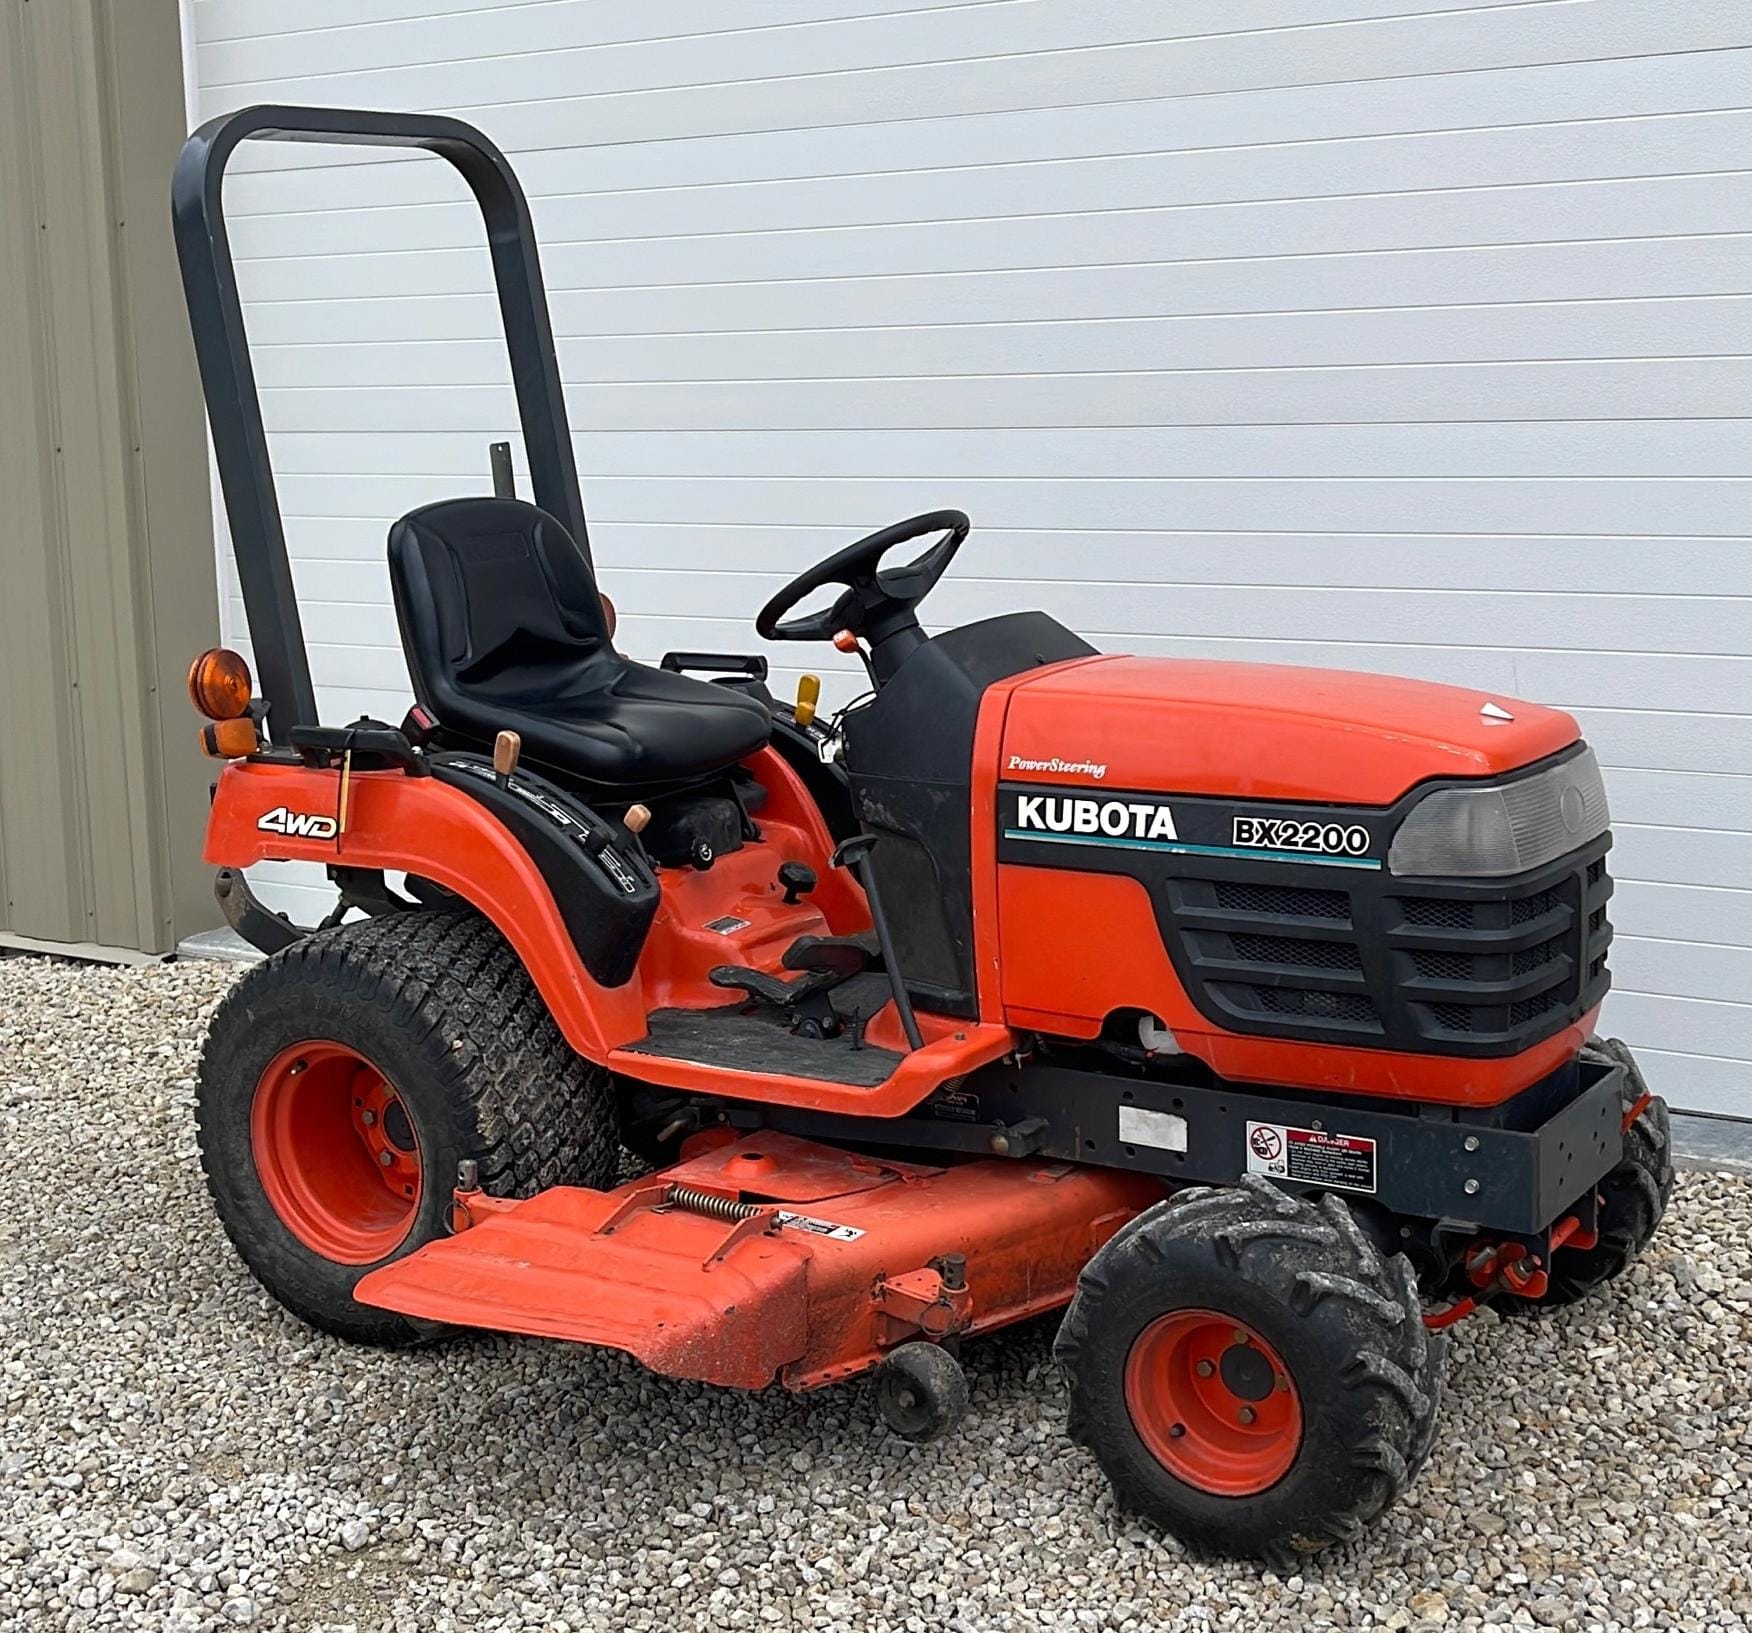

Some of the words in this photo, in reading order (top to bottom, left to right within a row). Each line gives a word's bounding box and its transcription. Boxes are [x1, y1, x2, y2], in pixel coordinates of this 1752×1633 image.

[1008, 755, 1107, 779] PowerSteering
[257, 807, 338, 839] 4WD
[1018, 796, 1178, 840] KUBOTA
[1232, 817, 1370, 855] BX2200
